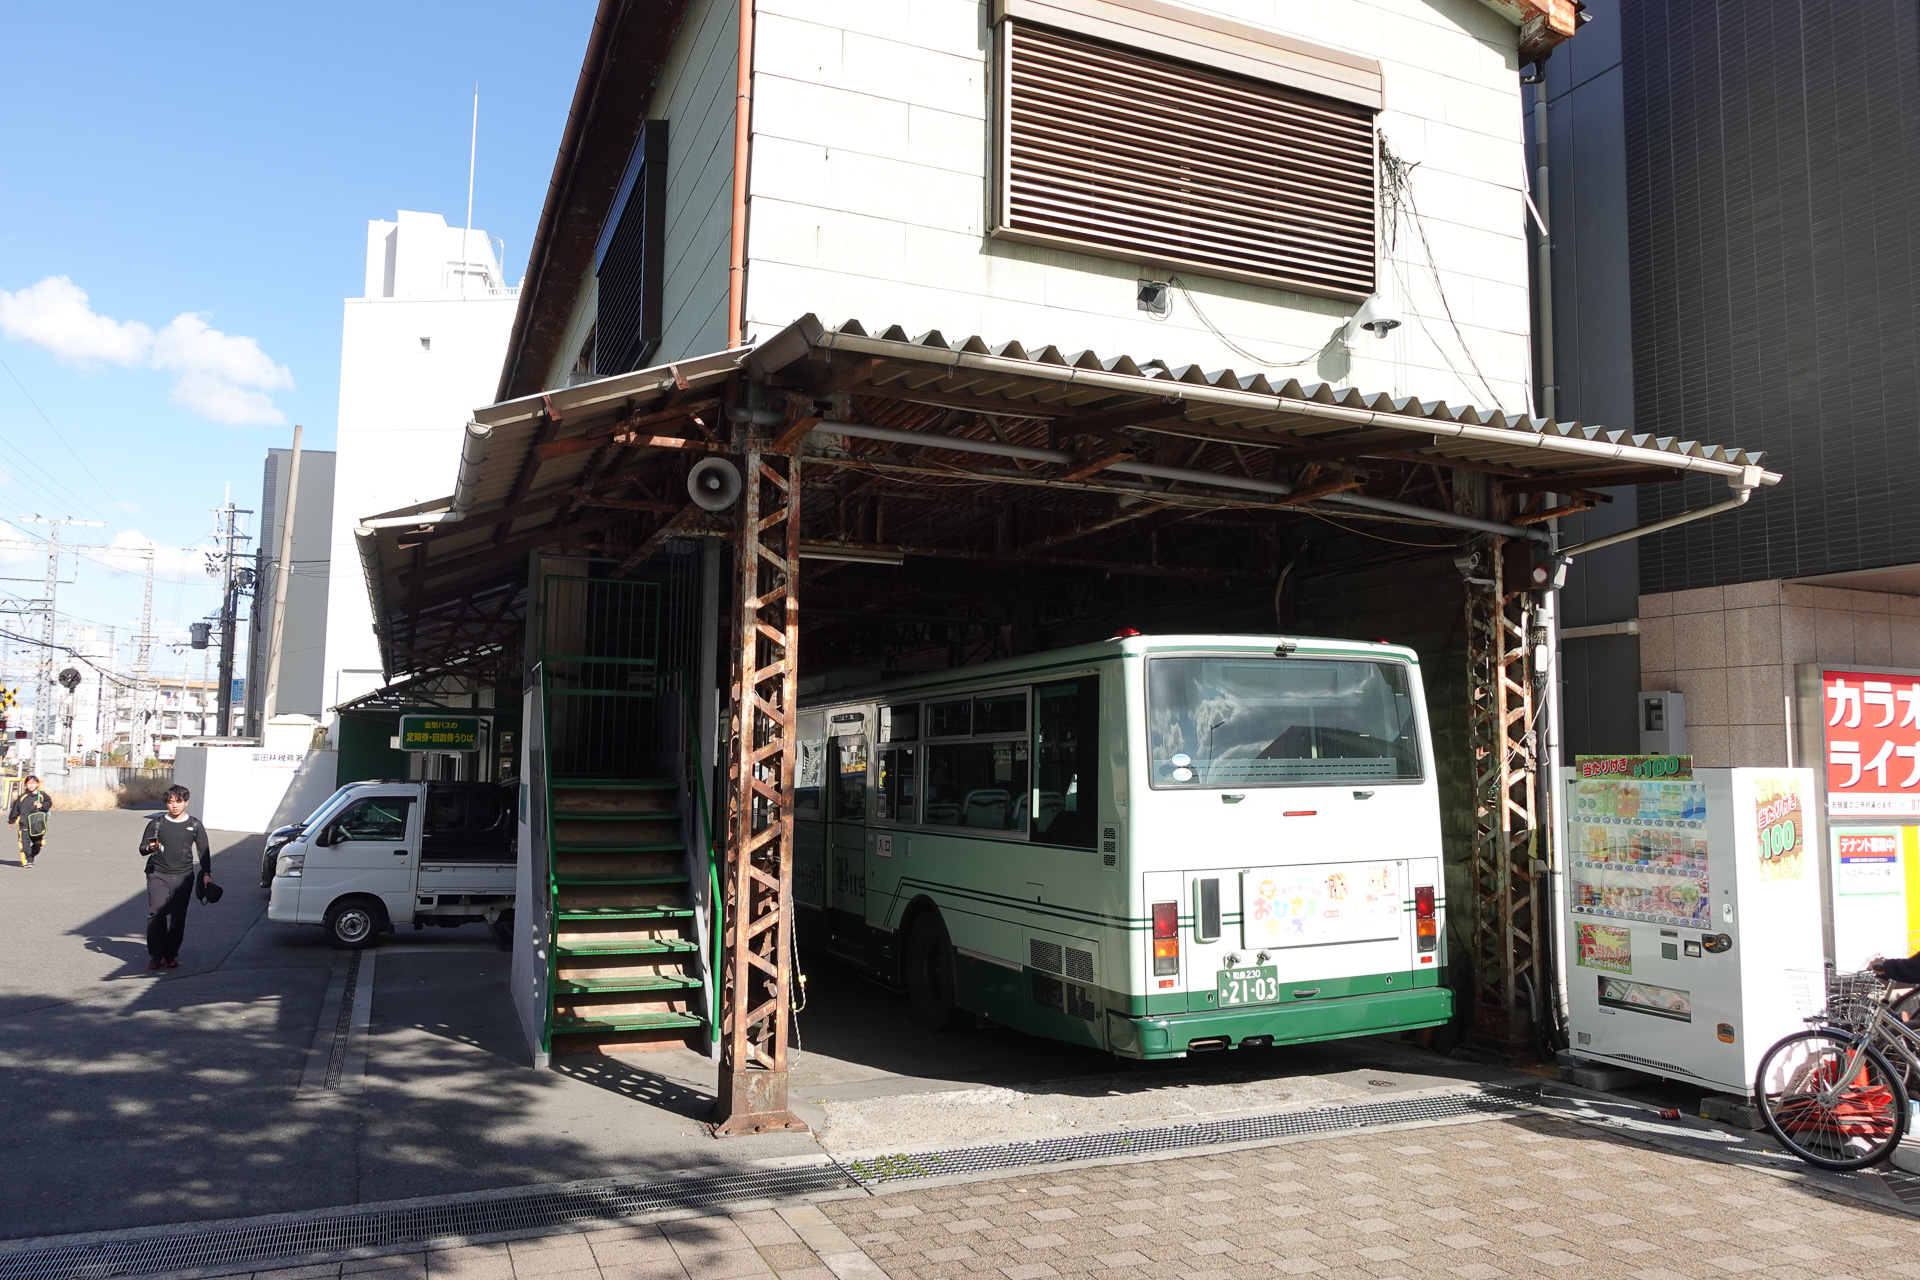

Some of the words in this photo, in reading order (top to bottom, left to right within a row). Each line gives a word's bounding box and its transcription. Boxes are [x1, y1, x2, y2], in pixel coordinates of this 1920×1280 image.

[424, 721, 458, 729] 金剛バスの
[406, 732, 475, 743] 定期券・回数券うりば
[1582, 757, 1628, 778] 当たり付き
[1758, 792, 1798, 829] 当たり付き
[878, 838, 891, 853] 入口
[1840, 836, 1895, 853] テナント募集中
[835, 856, 865, 902] Bus
[1253, 896, 1318, 920] おひさま
[1229, 977, 1277, 1003] 21-03
